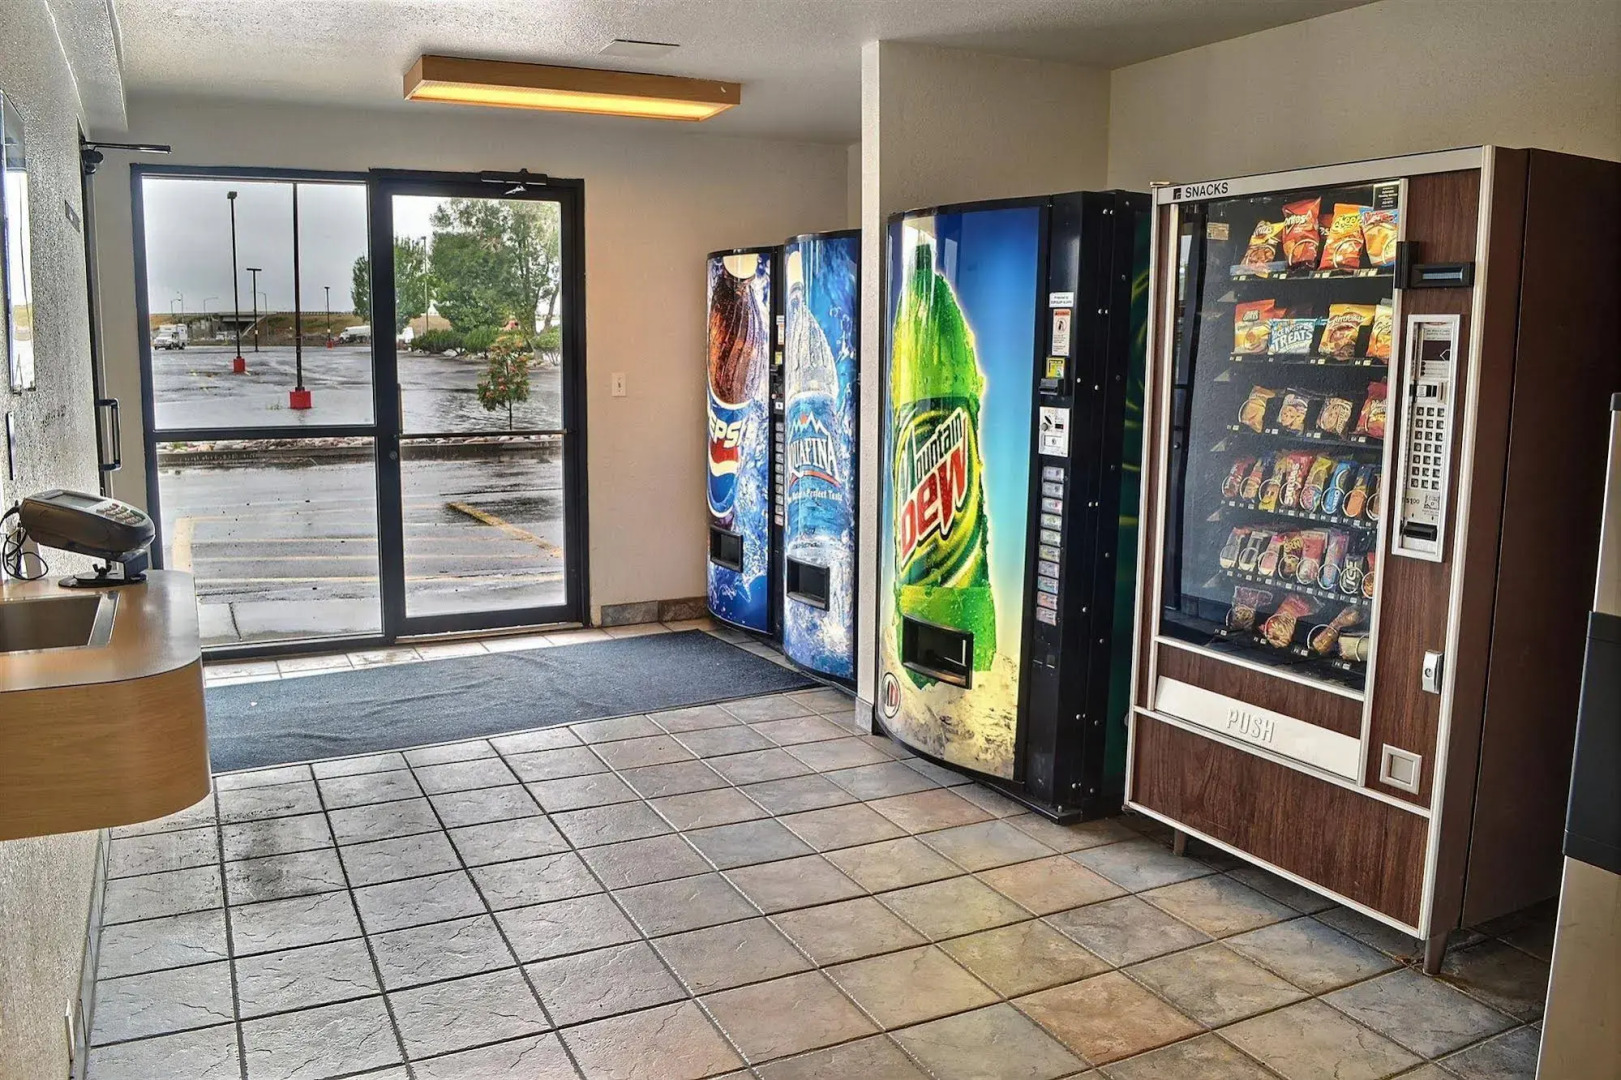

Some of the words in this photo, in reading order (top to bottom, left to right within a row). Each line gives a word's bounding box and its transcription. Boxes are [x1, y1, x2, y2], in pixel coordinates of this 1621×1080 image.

[1185, 182, 1229, 198] SNACKS
[1275, 330, 1313, 352] TREATS
[709, 408, 750, 449] EPSI
[1345, 560, 1357, 585] ICE
[1226, 708, 1276, 743] PUSH
